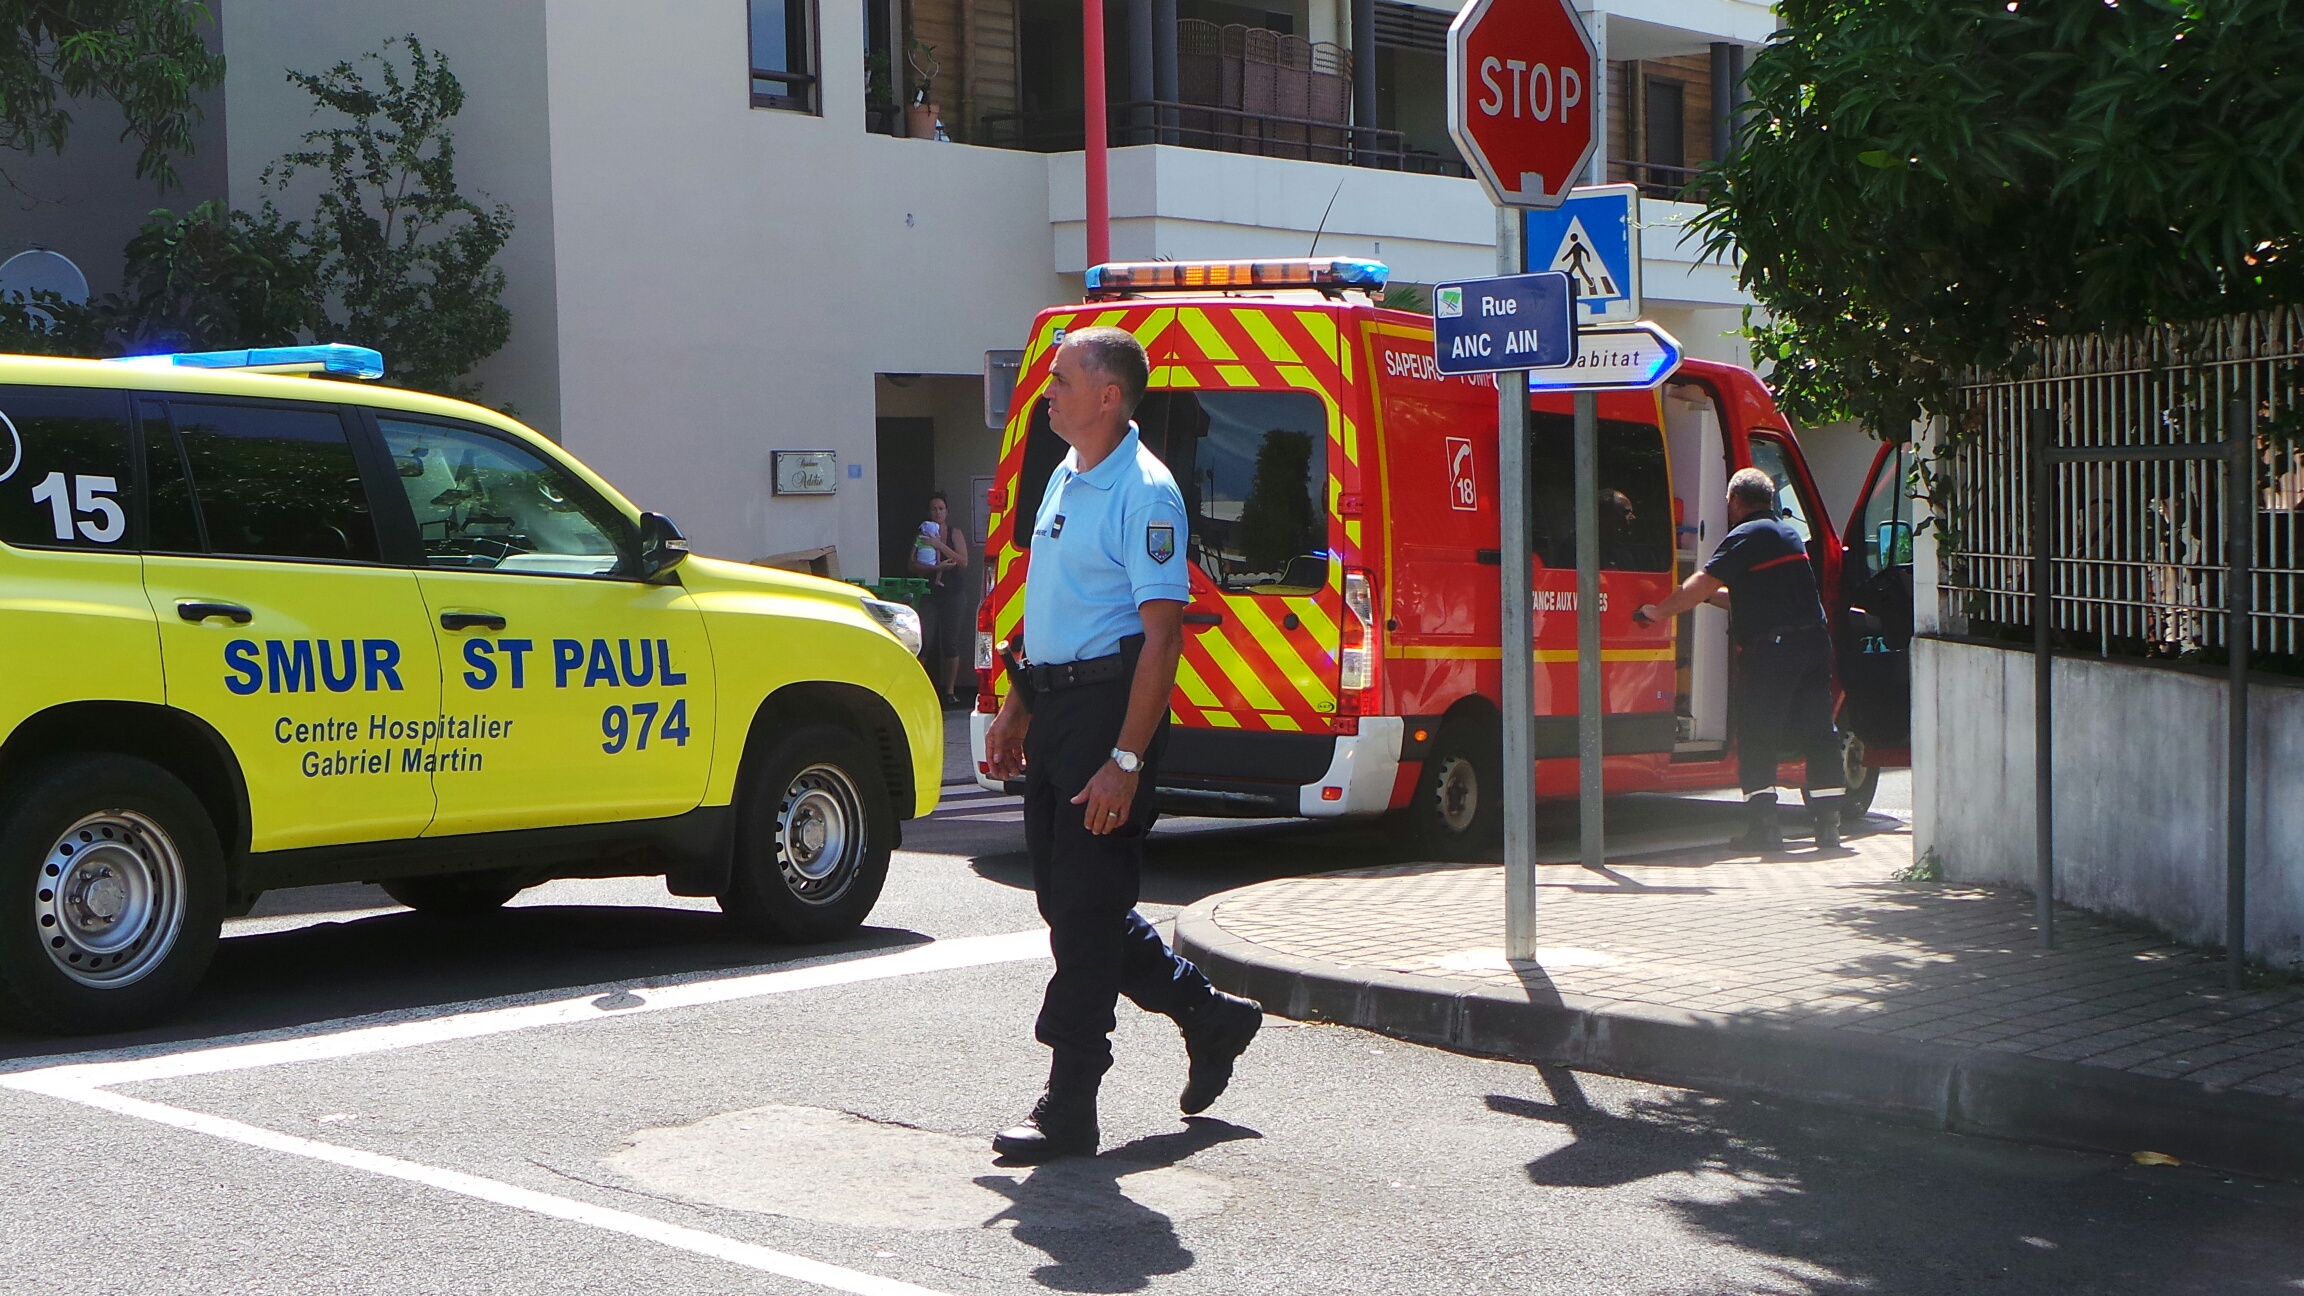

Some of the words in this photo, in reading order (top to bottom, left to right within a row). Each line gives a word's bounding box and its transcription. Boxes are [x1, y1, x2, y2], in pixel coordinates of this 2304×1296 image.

[1479, 55, 1582, 124] STOP
[1481, 296, 1517, 317] Rue
[1451, 333, 1492, 359] ANC
[1504, 329, 1538, 354] AIN
[1576, 350, 1640, 368] abitat
[1456, 477, 1474, 504] 18
[31, 471, 126, 543] 15
[1556, 592, 1572, 612] AUX
[223, 638, 405, 696] SMUR
[462, 638, 534, 691] ST
[552, 638, 688, 688] PAUL
[274, 716, 358, 744] Centre
[368, 714, 514, 746] Hospitalier
[601, 698, 691, 755] 974
[301, 748, 392, 778] Gabriel
[401, 747, 483, 773] Martin
